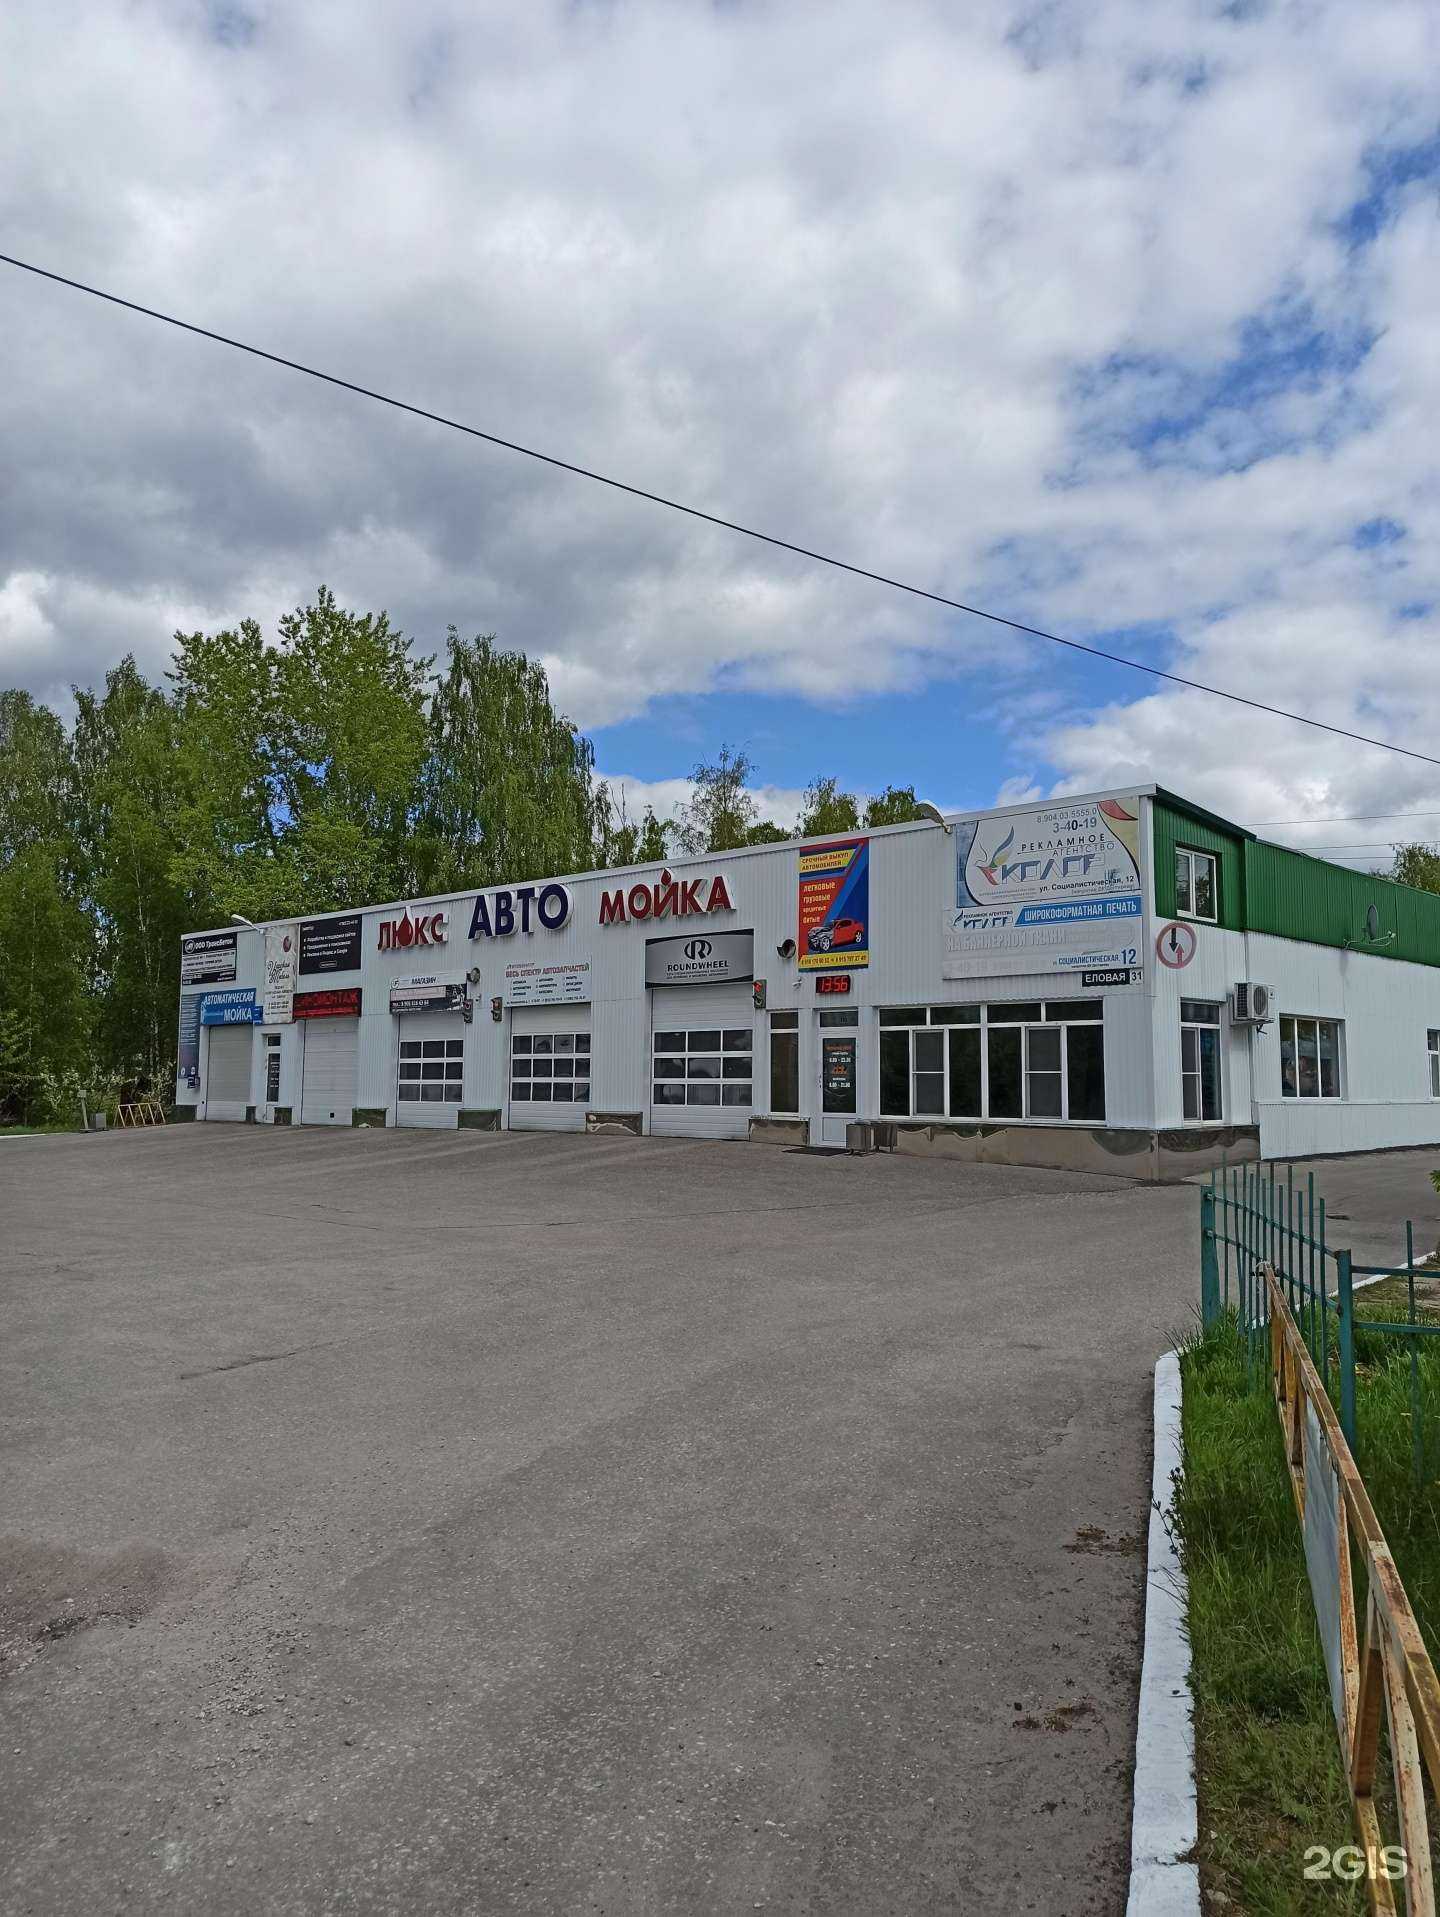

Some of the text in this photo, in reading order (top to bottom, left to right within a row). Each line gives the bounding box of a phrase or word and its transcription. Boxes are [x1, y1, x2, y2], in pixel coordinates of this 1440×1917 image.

[1053, 817, 1097, 833] 3-40-19
[1022, 833, 1104, 851] РЕКЛАМНОЕ
[1053, 842, 1115, 857] АГЕНТСТВО
[801, 852, 849, 864] СРОЧНЫЙ ВЫКУП
[801, 861, 842, 871] АВТОМОБИЛЕЙ
[1039, 885, 1048, 893] ул.
[1126, 875, 1135, 883] 12
[599, 868, 736, 925] МОЙКА
[467, 883, 571, 940] АВТО
[1024, 900, 1137, 922] ШИРОКОФОРМАТНАЯ ПЕЧАТЬ
[1121, 948, 1137, 964] 12
[667, 960, 729, 972] ROUNDWHEEL
[1085, 971, 1142, 983] ЕЛОВАЯ 31
[203, 991, 255, 1006] АВТОМАТИЧЕСКАЯ
[224, 1006, 253, 1022] МОЙКА
